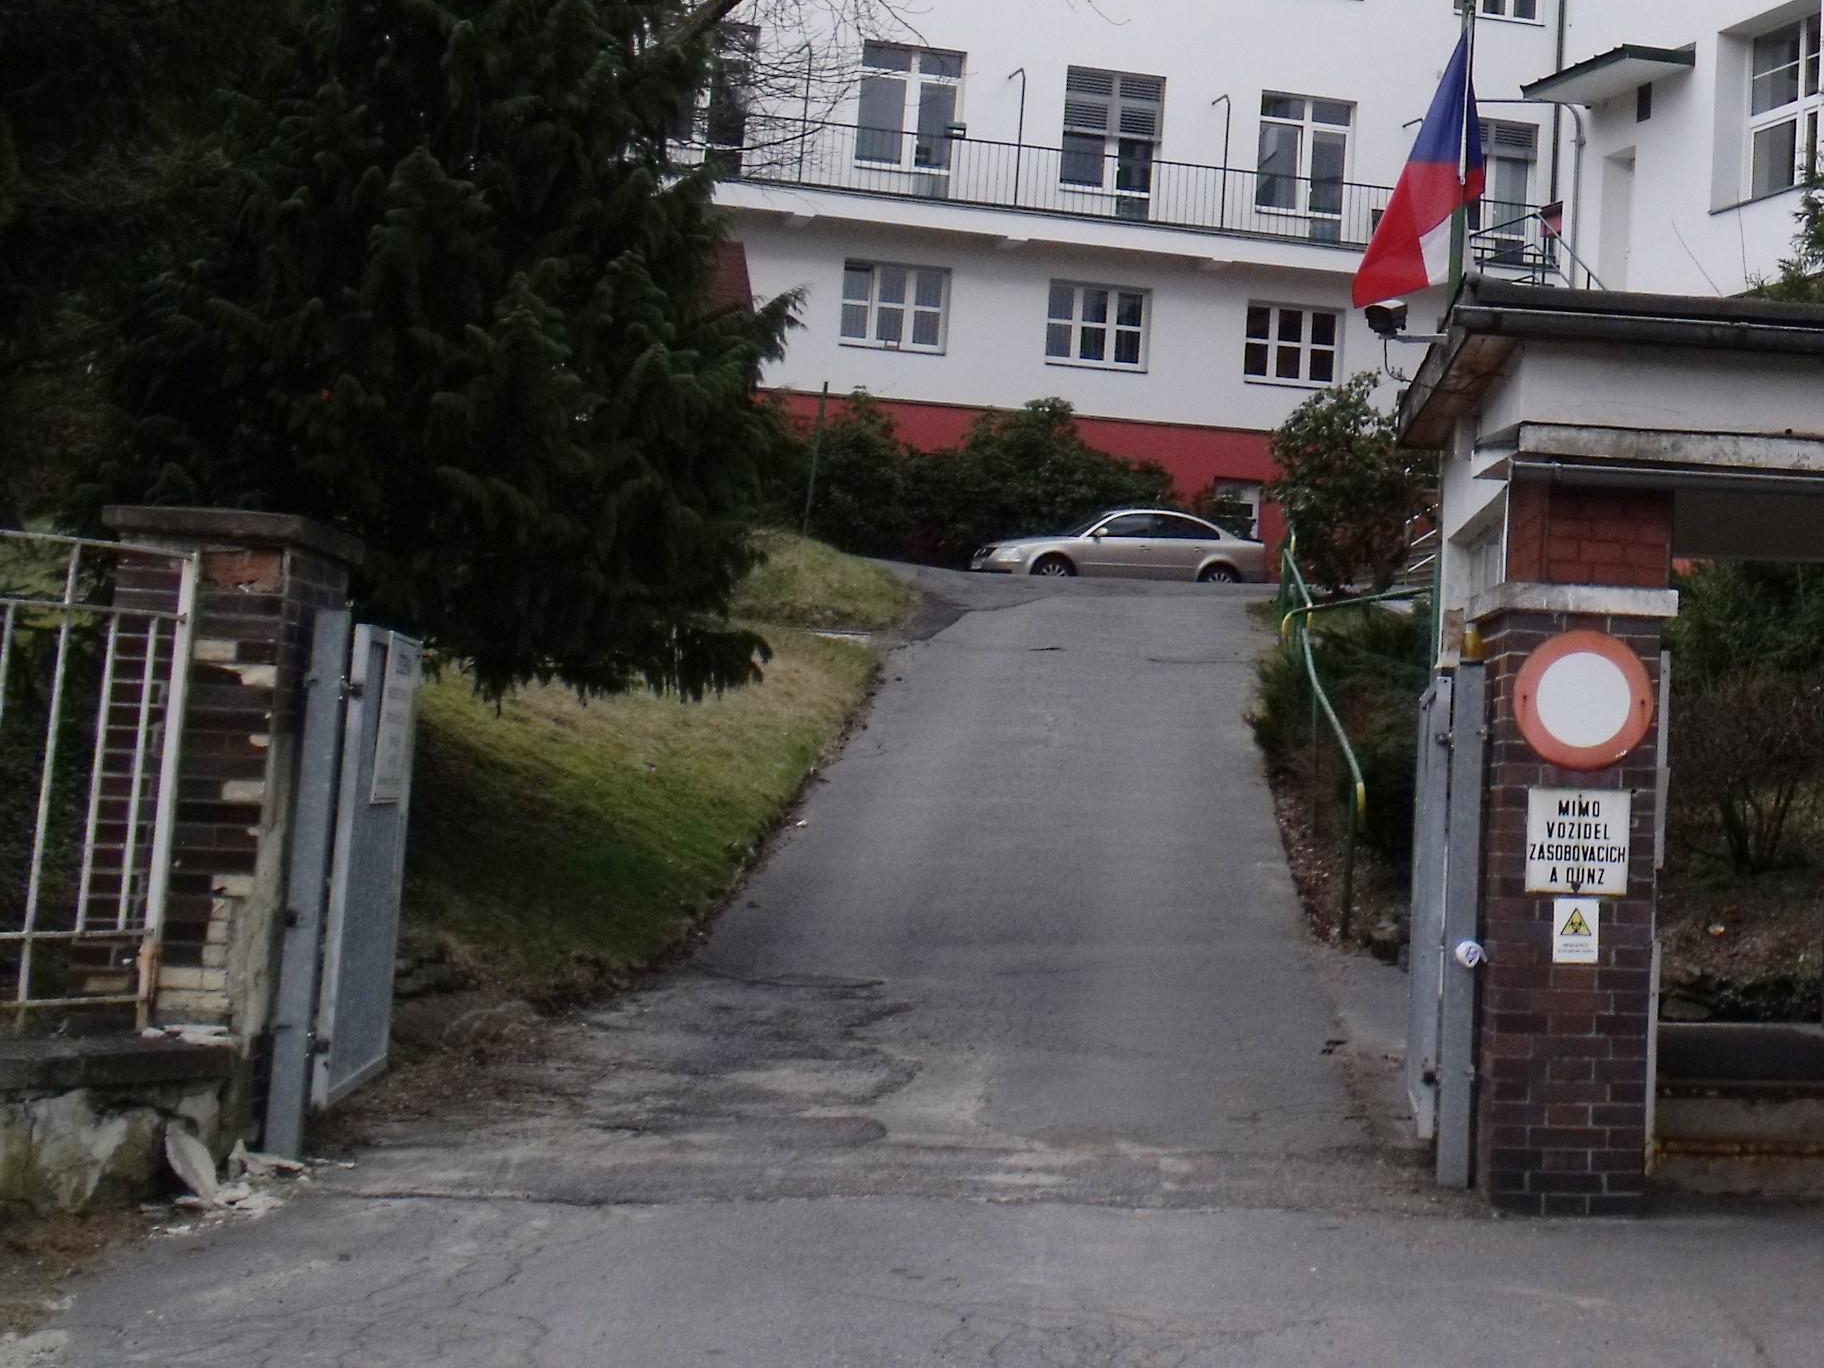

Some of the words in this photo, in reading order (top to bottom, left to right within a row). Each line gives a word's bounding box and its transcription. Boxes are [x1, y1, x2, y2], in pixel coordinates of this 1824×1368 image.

[1558, 800, 1600, 817] MIMO
[1546, 821, 1610, 840] VOZIDEL
[1549, 866, 1558, 883] A
